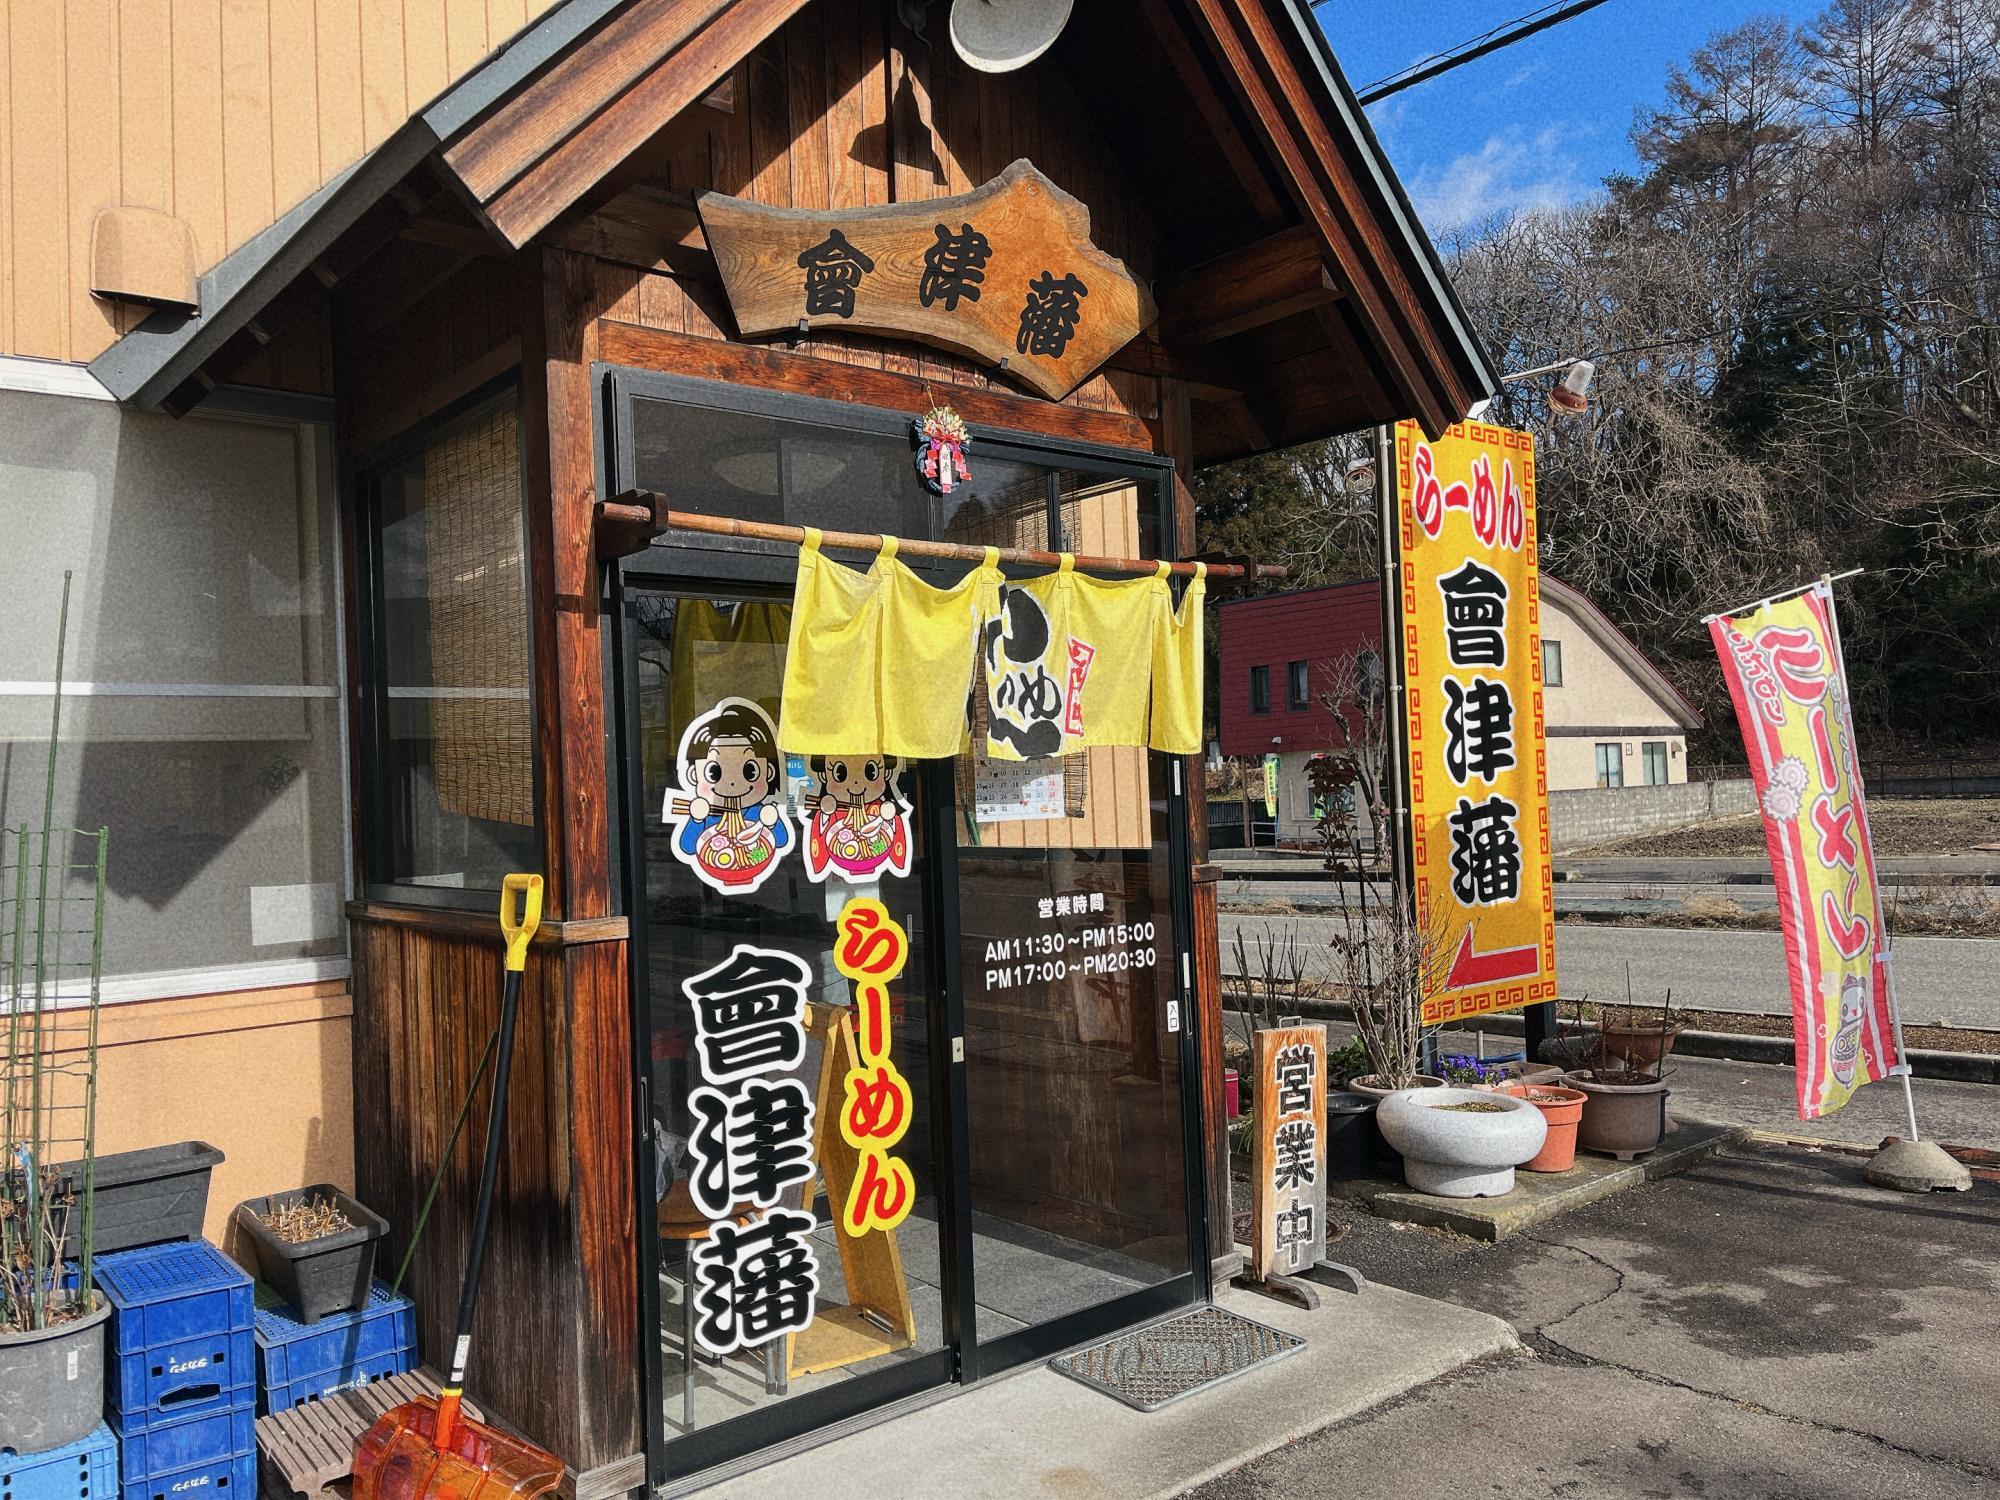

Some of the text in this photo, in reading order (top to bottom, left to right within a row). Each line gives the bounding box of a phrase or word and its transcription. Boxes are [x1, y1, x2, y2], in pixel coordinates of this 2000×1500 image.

[797, 223, 1089, 359] 會津藩
[1415, 444, 1524, 551] らーめん
[1439, 560, 1520, 906] 會津藩
[1038, 893, 1104, 919] 営業時間
[840, 905, 911, 1229] らーめん
[1169, 1005, 1177, 1028] 入口
[684, 946, 818, 1352] 會津藩
[1275, 1045, 1316, 1266] 営業中
